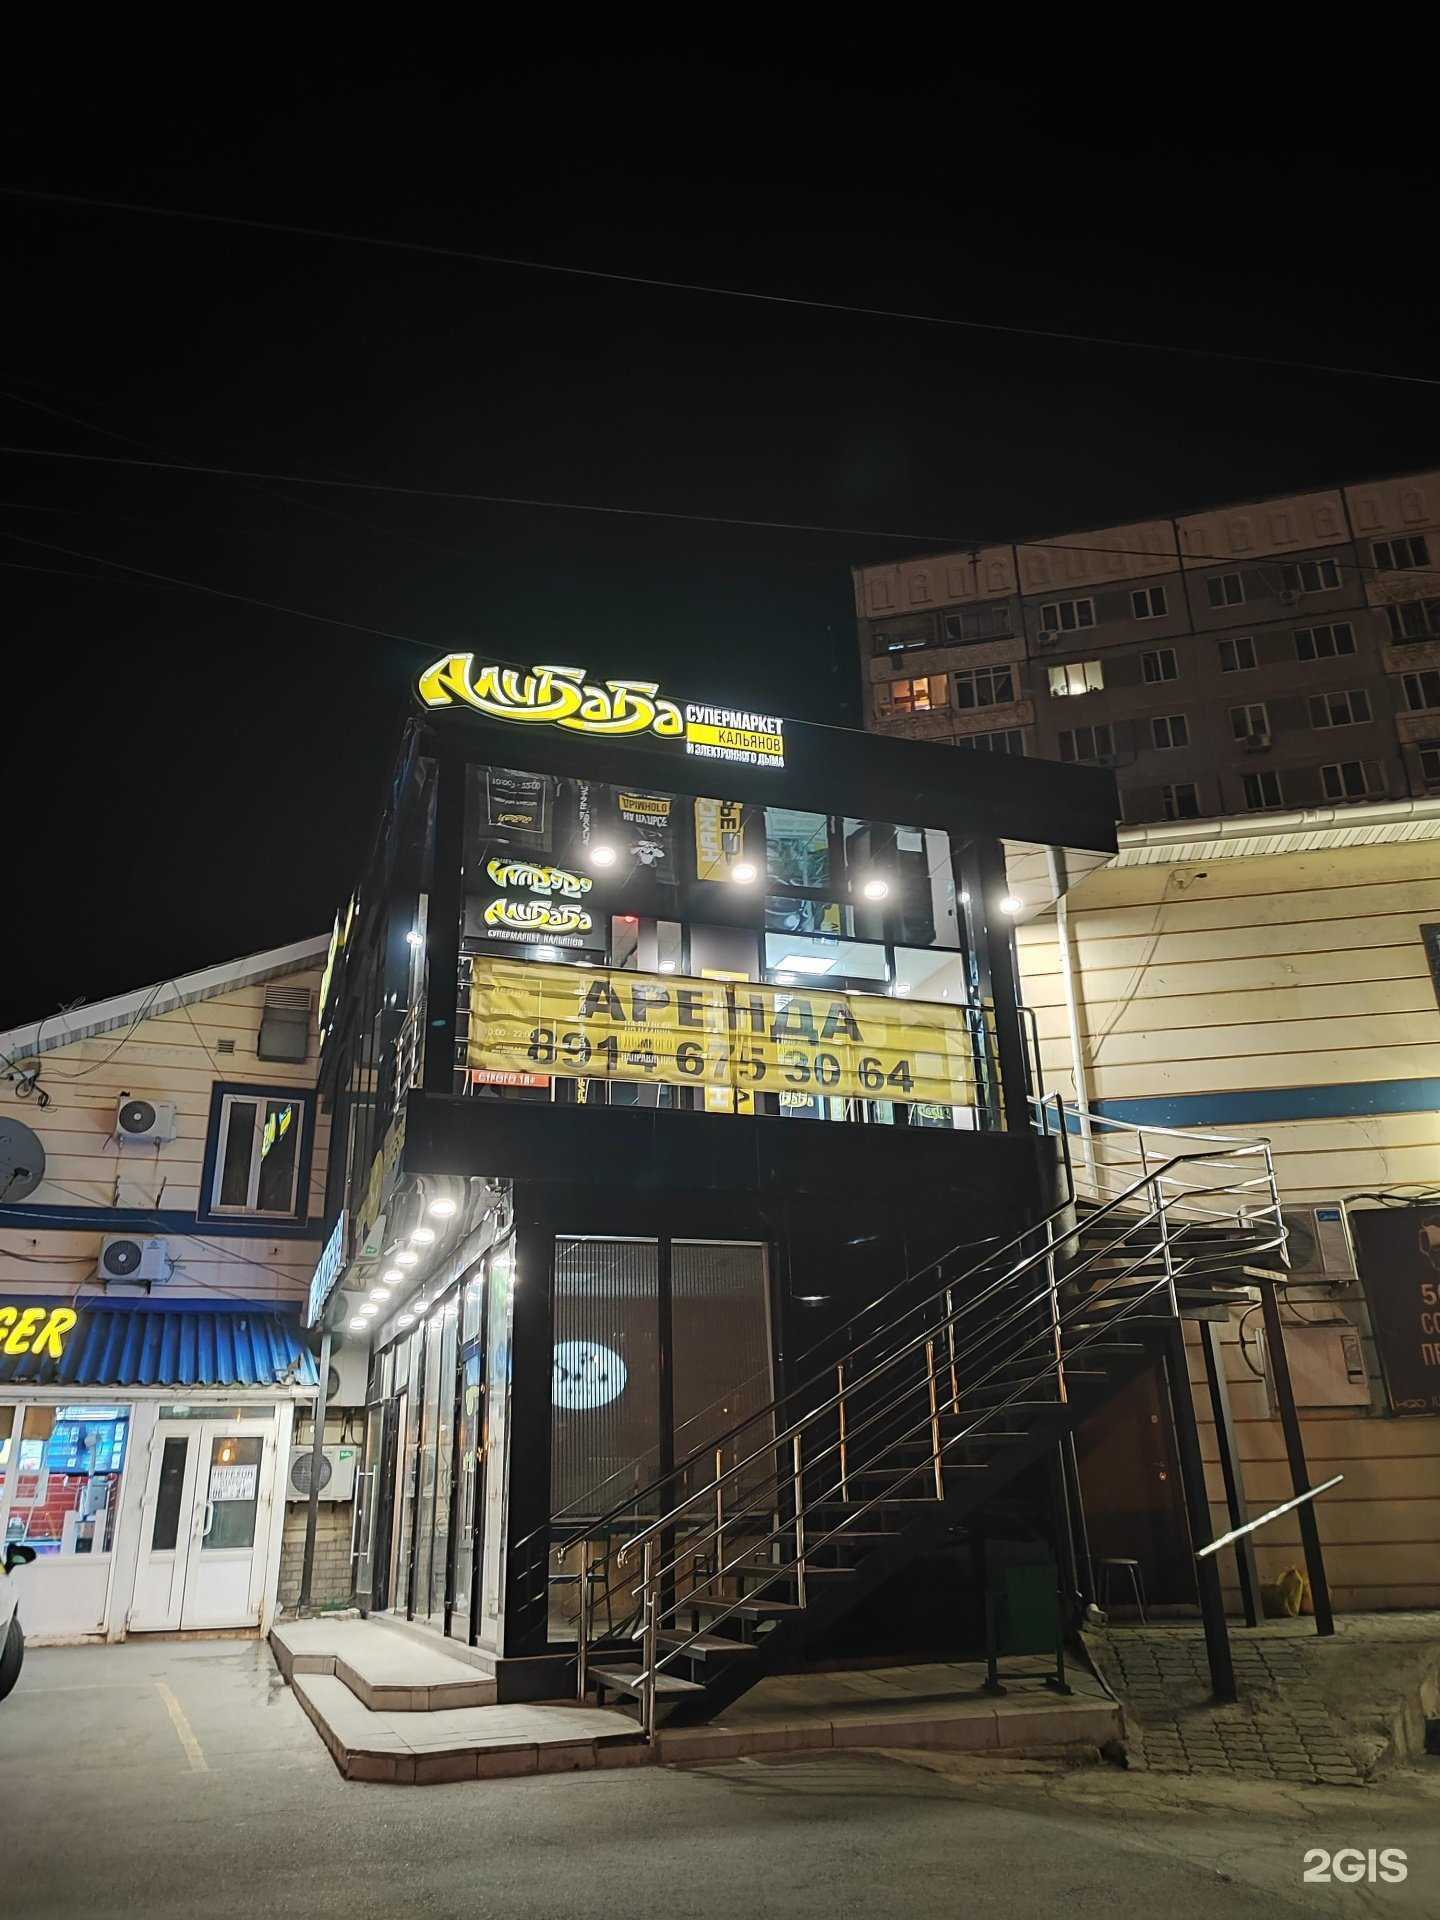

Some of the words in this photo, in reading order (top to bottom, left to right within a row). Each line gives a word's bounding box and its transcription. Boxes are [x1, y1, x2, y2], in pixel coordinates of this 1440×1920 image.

[686, 704, 783, 735] СУПЕРМАРКЕТ
[686, 742, 695, 755] И
[695, 743, 757, 764] ЭЛЕКТРОННОГО
[757, 753, 785, 768] ДЫМА
[718, 730, 781, 752] КАЛЬЯНОВ
[577, 980, 864, 1046] АРЕНДА
[526, 1027, 659, 1073] 8914
[675, 1040, 768, 1083] 675
[784, 1048, 842, 1090] 30
[857, 1056, 915, 1095] 64
[1421, 1283, 1440, 1305] 5
